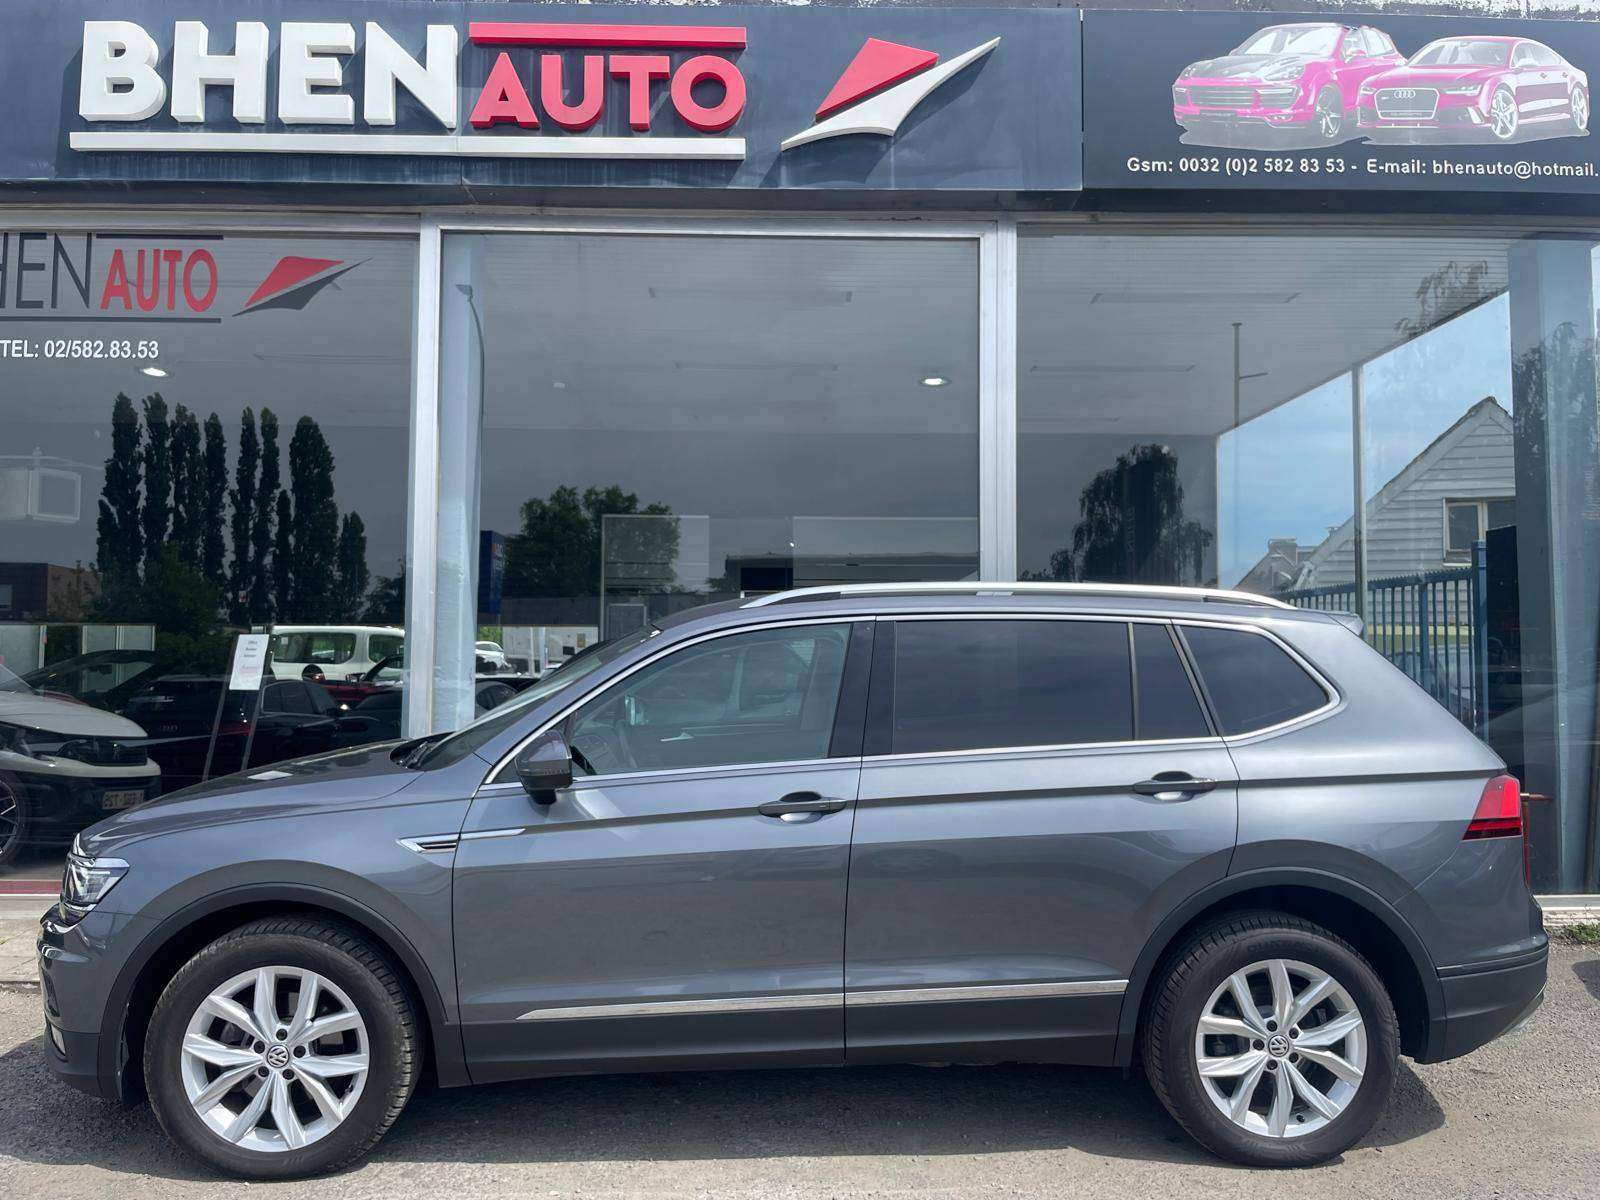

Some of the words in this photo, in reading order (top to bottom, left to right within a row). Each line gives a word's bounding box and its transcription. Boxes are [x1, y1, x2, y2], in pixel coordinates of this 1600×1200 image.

[469, 52, 747, 132] AUTO
[1127, 156, 1173, 173] Gsm:
[1179, 157, 1220, 173] 0032
[1225, 157, 1258, 176] (0)2
[1263, 158, 1294, 173] 582
[1299, 158, 1320, 173] 83
[1325, 158, 1345, 173] 53
[1366, 158, 1427, 174] E-mail:
[1432, 159, 1600, 180] bhenauto@hotmail.
[100, 248, 219, 312] AUTO
[0, 339, 40, 359] TEL:
[44, 339, 160, 359] 02/582.83.53
